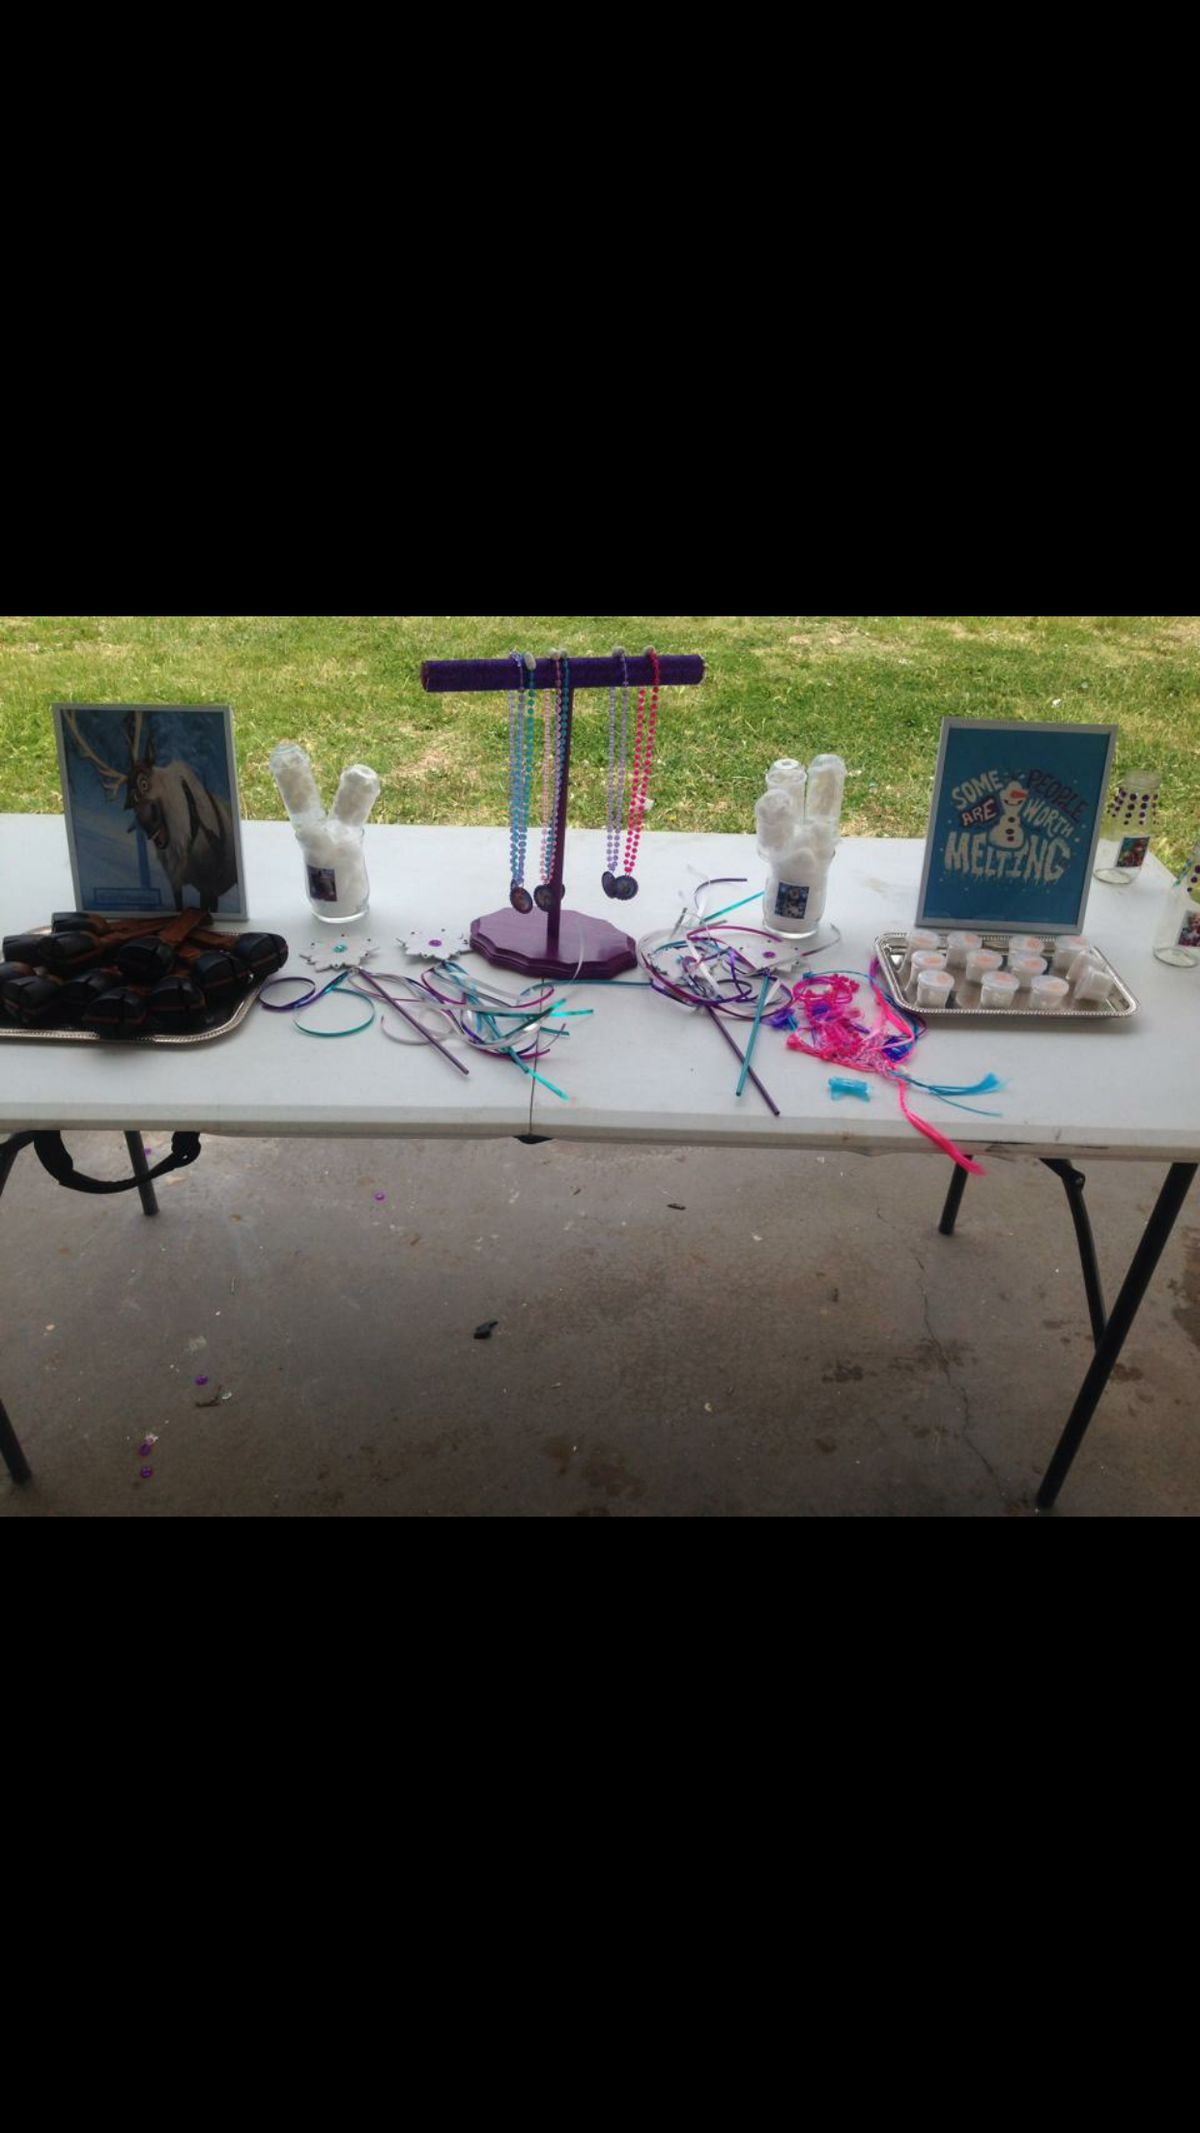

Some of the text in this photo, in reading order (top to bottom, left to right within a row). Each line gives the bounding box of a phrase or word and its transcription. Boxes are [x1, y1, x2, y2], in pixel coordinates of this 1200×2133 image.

[952, 769, 1088, 823] SOME PEOPLE
[961, 798, 1075, 837] ARE WORTH
[944, 831, 1071, 882] MELTING
